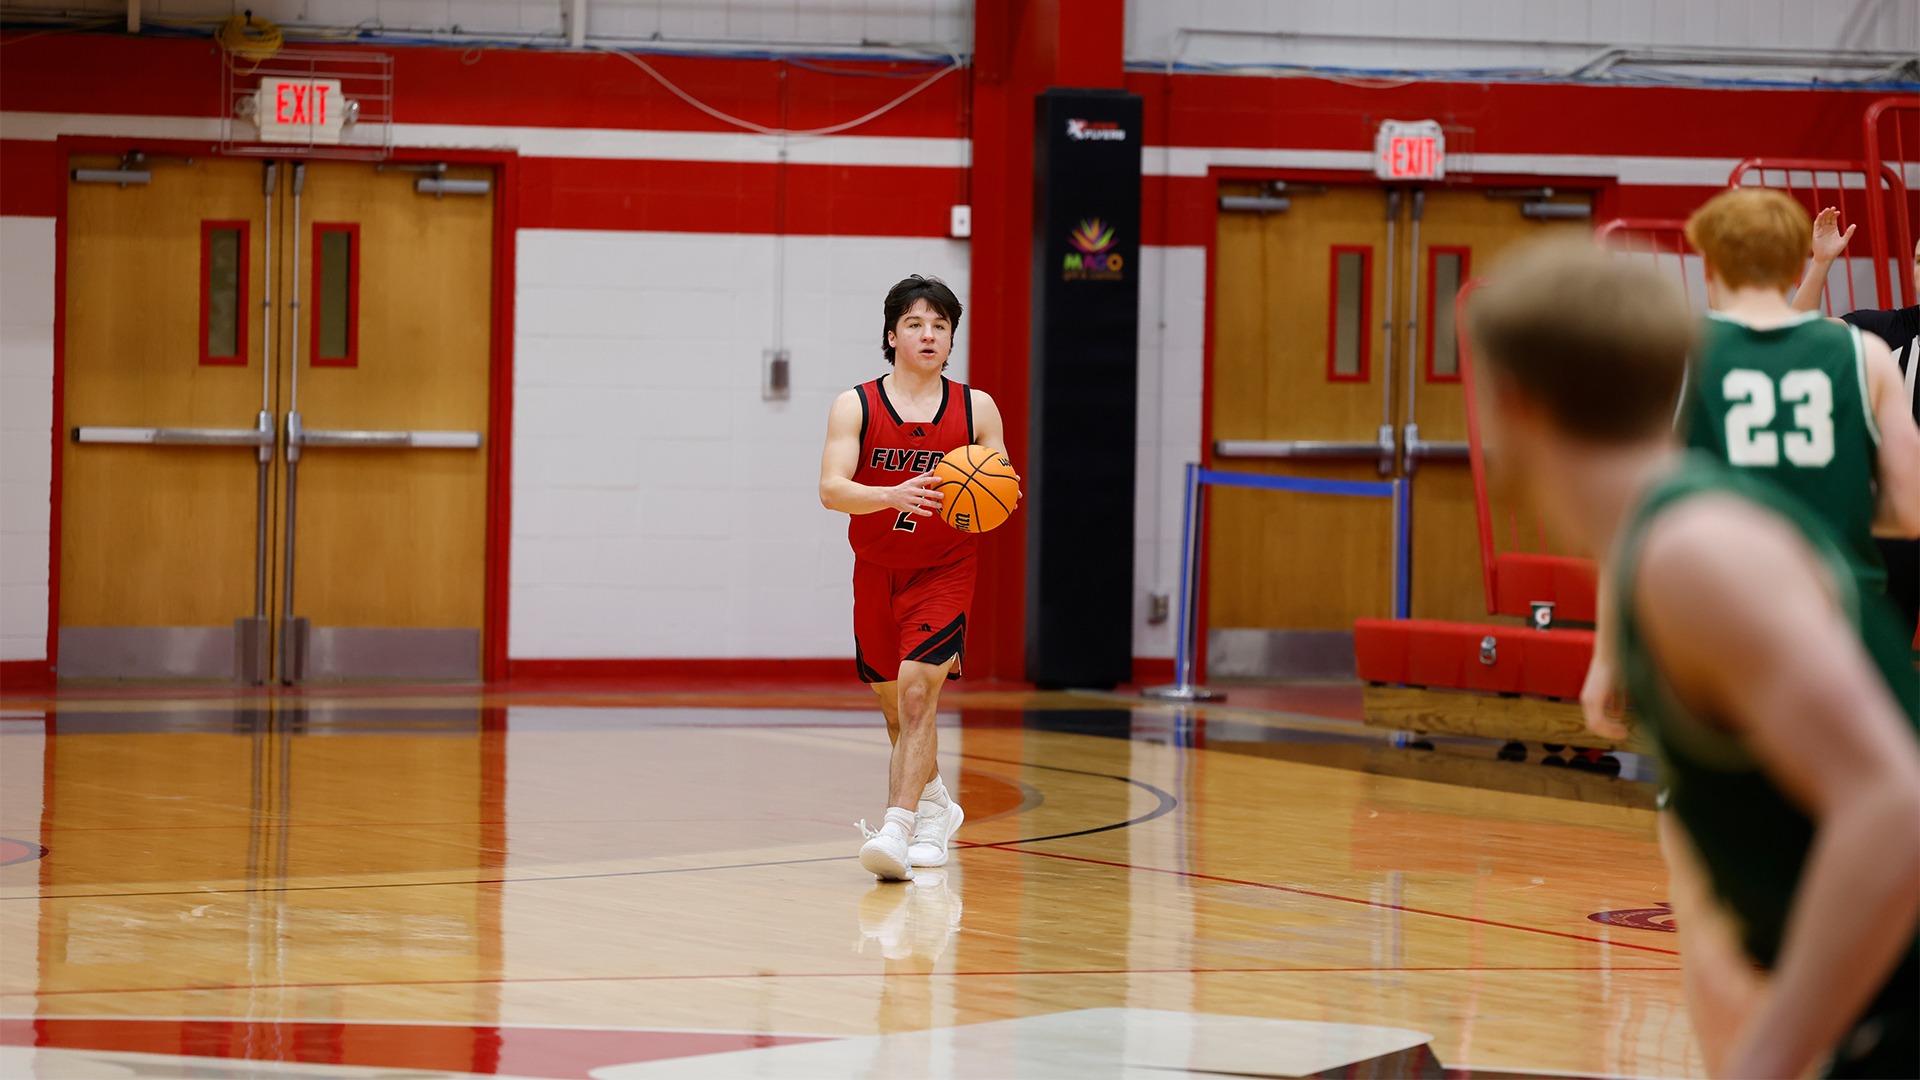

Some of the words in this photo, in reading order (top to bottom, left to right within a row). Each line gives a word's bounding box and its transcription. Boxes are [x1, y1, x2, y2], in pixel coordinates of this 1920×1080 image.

[276, 83, 330, 125] EXIT
[1391, 137, 1435, 177] EXIT
[1722, 368, 1835, 468] 23
[870, 447, 946, 473] FLYER
